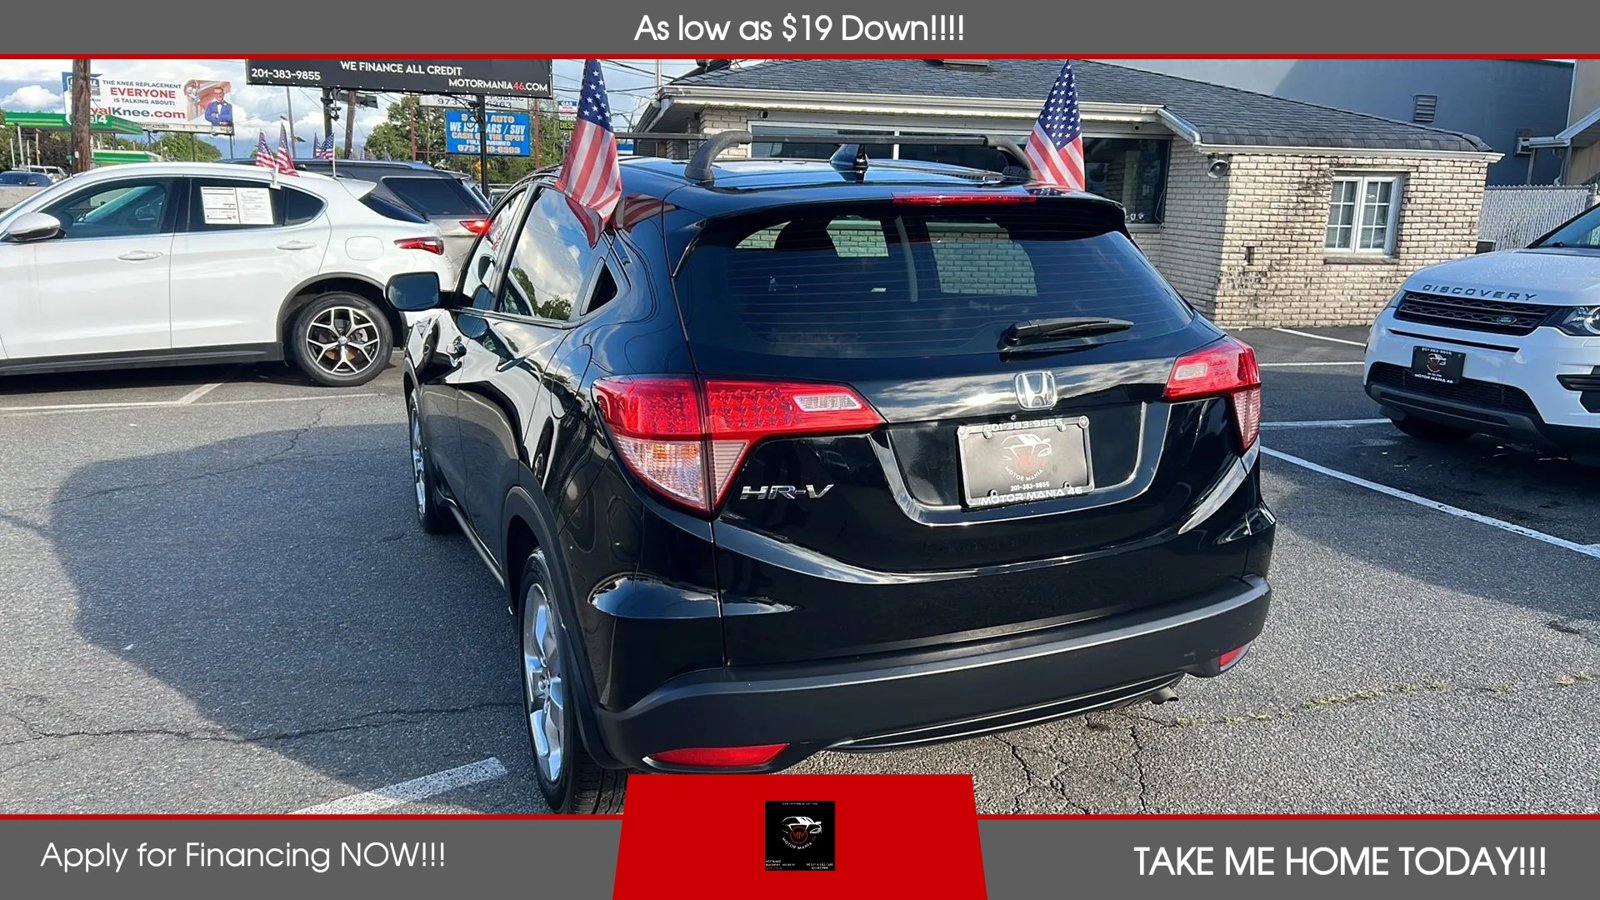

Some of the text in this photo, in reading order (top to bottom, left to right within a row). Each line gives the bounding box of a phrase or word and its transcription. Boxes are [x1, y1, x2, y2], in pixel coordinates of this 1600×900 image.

[251, 67, 321, 80] 201-383-9855
[340, 61, 463, 76] WE FINANCE ALL CREDIT
[135, 81, 181, 89] REPLACEMENT
[448, 78, 548, 92] MOTORMANIA46.COM
[110, 87, 177, 99] EVERYONE
[121, 97, 149, 105] TALKING
[150, 98, 175, 106] ABOUT!
[90, 106, 186, 119] yalKnee.com
[490, 115, 515, 123] AUTO
[450, 122, 462, 132] WE
[486, 124, 502, 134] ARS
[509, 125, 526, 134] SUV
[1422, 284, 1538, 301] DISCOVERY
[1004, 465, 1043, 481] MOTOR MANIA
[740, 483, 835, 500] HR-V
[980, 486, 1083, 506] MOTOR MANIA 46
